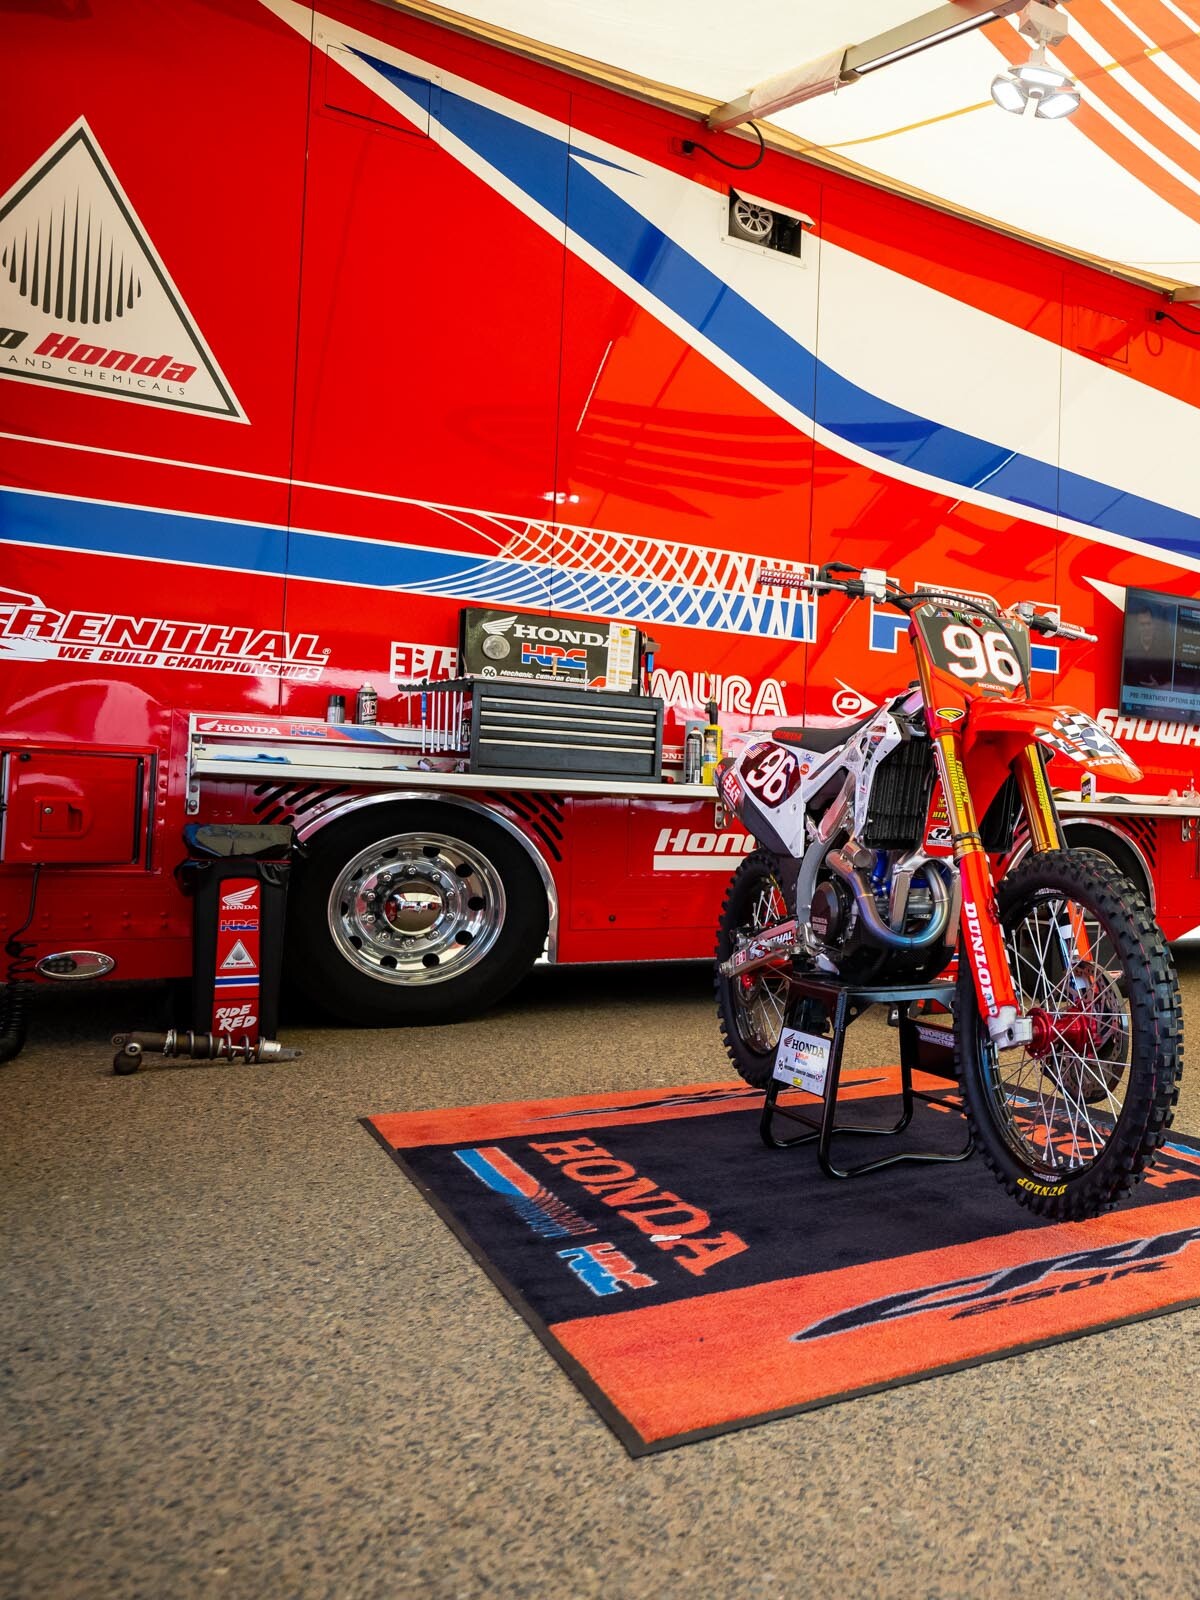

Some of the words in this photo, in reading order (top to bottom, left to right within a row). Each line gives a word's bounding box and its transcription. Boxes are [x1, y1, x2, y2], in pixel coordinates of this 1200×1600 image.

[33, 332, 198, 384] Honda
[8, 354, 52, 370] AND
[67, 365, 185, 395] CHEMICALS
[760, 570, 807, 581] RENTHAL
[57, 646, 92, 661] WE
[98, 648, 158, 665] BUILD
[164, 655, 321, 680] CHAMPIONSHIPS
[942, 624, 1023, 687] 96
[482, 667, 497, 679] 96
[977, 682, 1007, 692] HONDA
[217, 723, 281, 736] HONDA
[290, 724, 328, 737] HRC
[746, 748, 797, 802] 96
[220, 918, 259, 931] HRC
[964, 901, 1000, 1017] DUNLOP
[215, 1004, 253, 1019] RIDE
[218, 1015, 258, 1032] RED
[791, 1039, 825, 1059] HONDA
[1016, 1177, 1069, 1197] DUNLOP
[529, 1138, 750, 1277] HONDA
[557, 1242, 659, 1297] HRC
